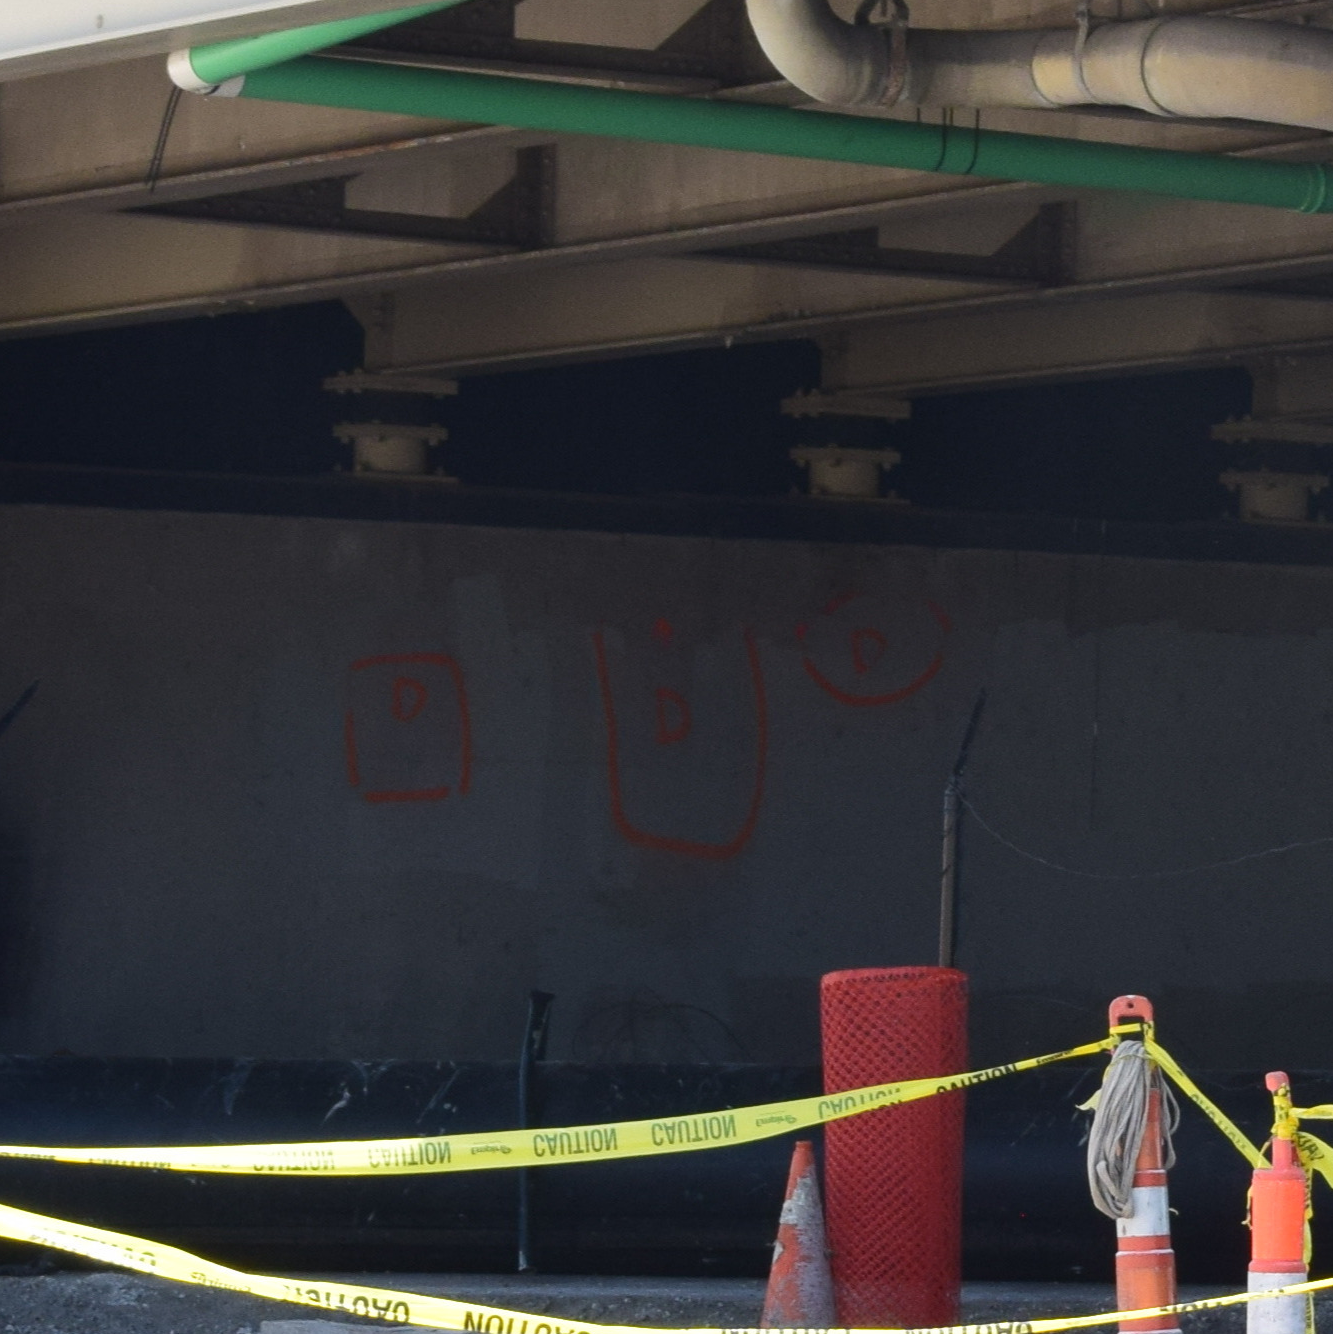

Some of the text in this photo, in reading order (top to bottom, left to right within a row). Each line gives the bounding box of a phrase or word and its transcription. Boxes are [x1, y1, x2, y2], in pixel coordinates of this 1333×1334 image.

[393, 674, 428, 722] D
[655, 686, 693, 746] D
[283, 1285, 411, 1323] CAUTIO
